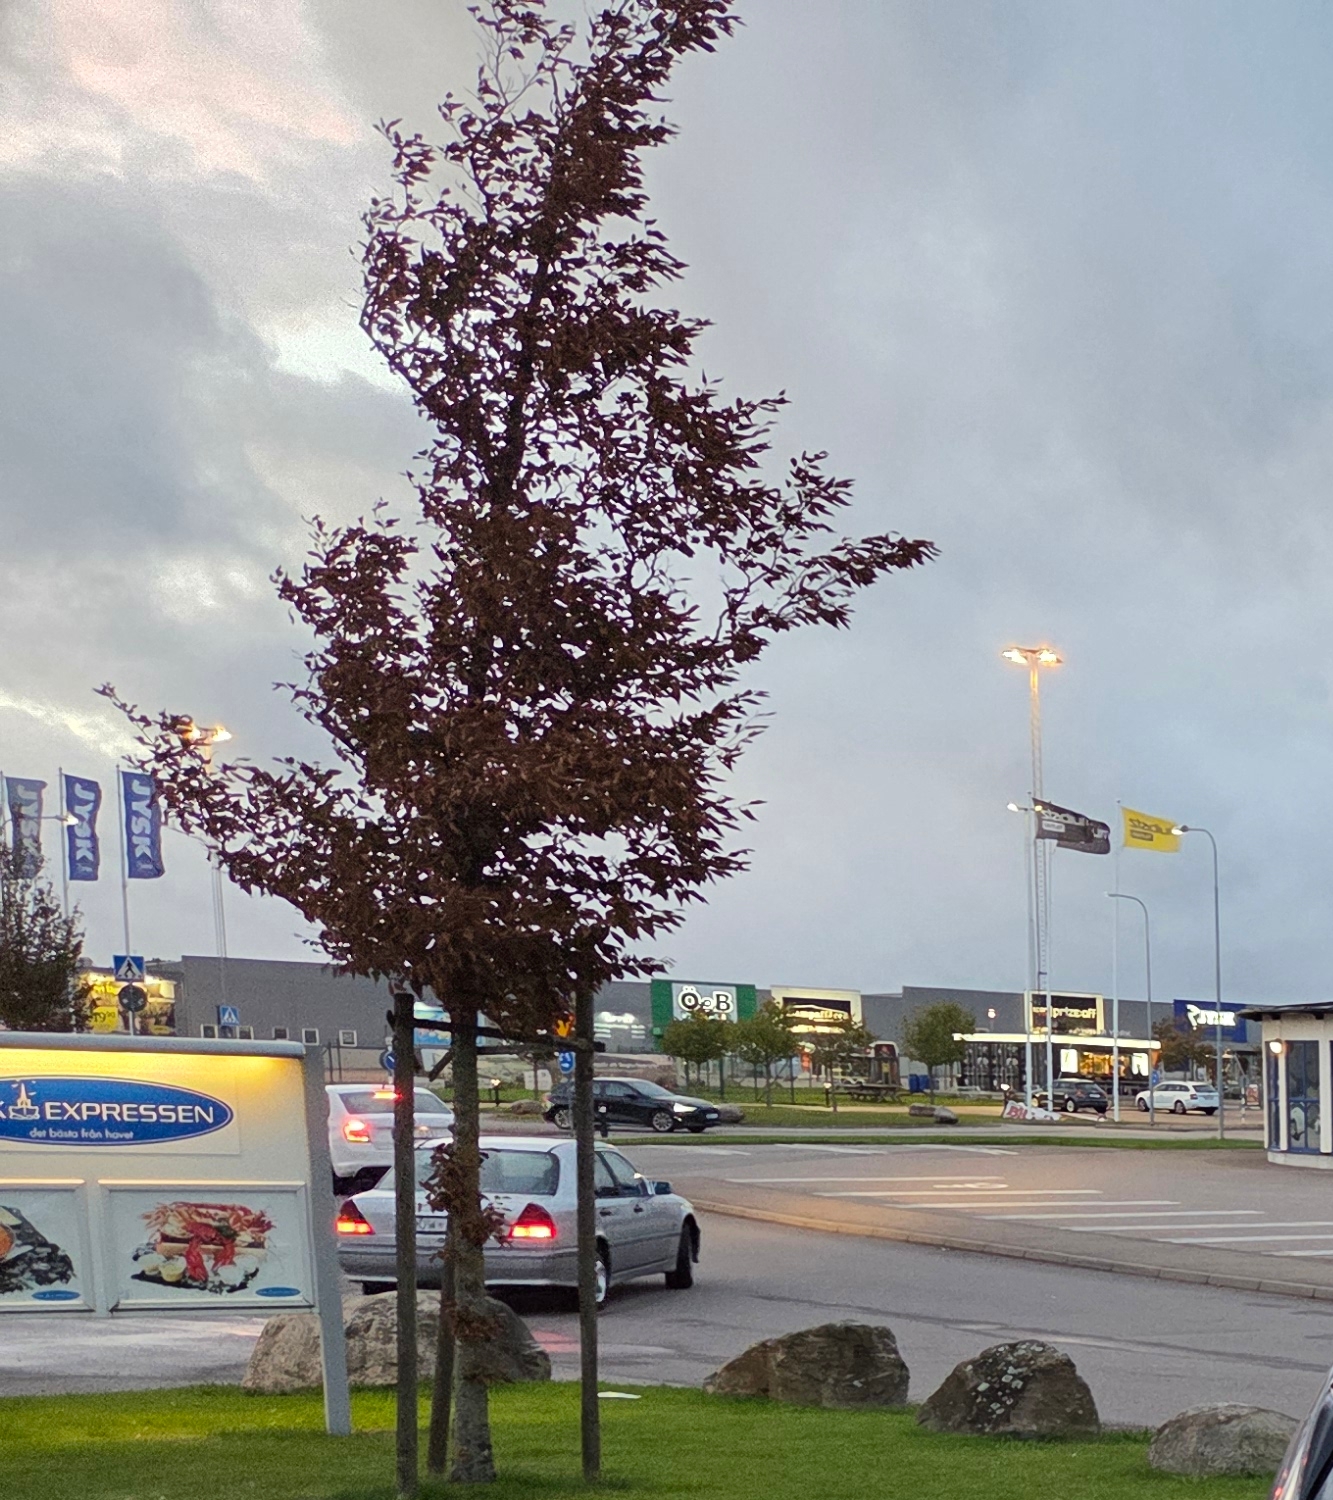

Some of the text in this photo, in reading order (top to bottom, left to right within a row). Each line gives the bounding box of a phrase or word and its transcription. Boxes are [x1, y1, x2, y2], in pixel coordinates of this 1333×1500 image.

[74, 782, 95, 862] JYSK
[131, 779, 152, 859] JYSK
[30, 1128, 134, 1139] det bästa från havet
[45, 1101, 214, 1124] EXPRESSEN
